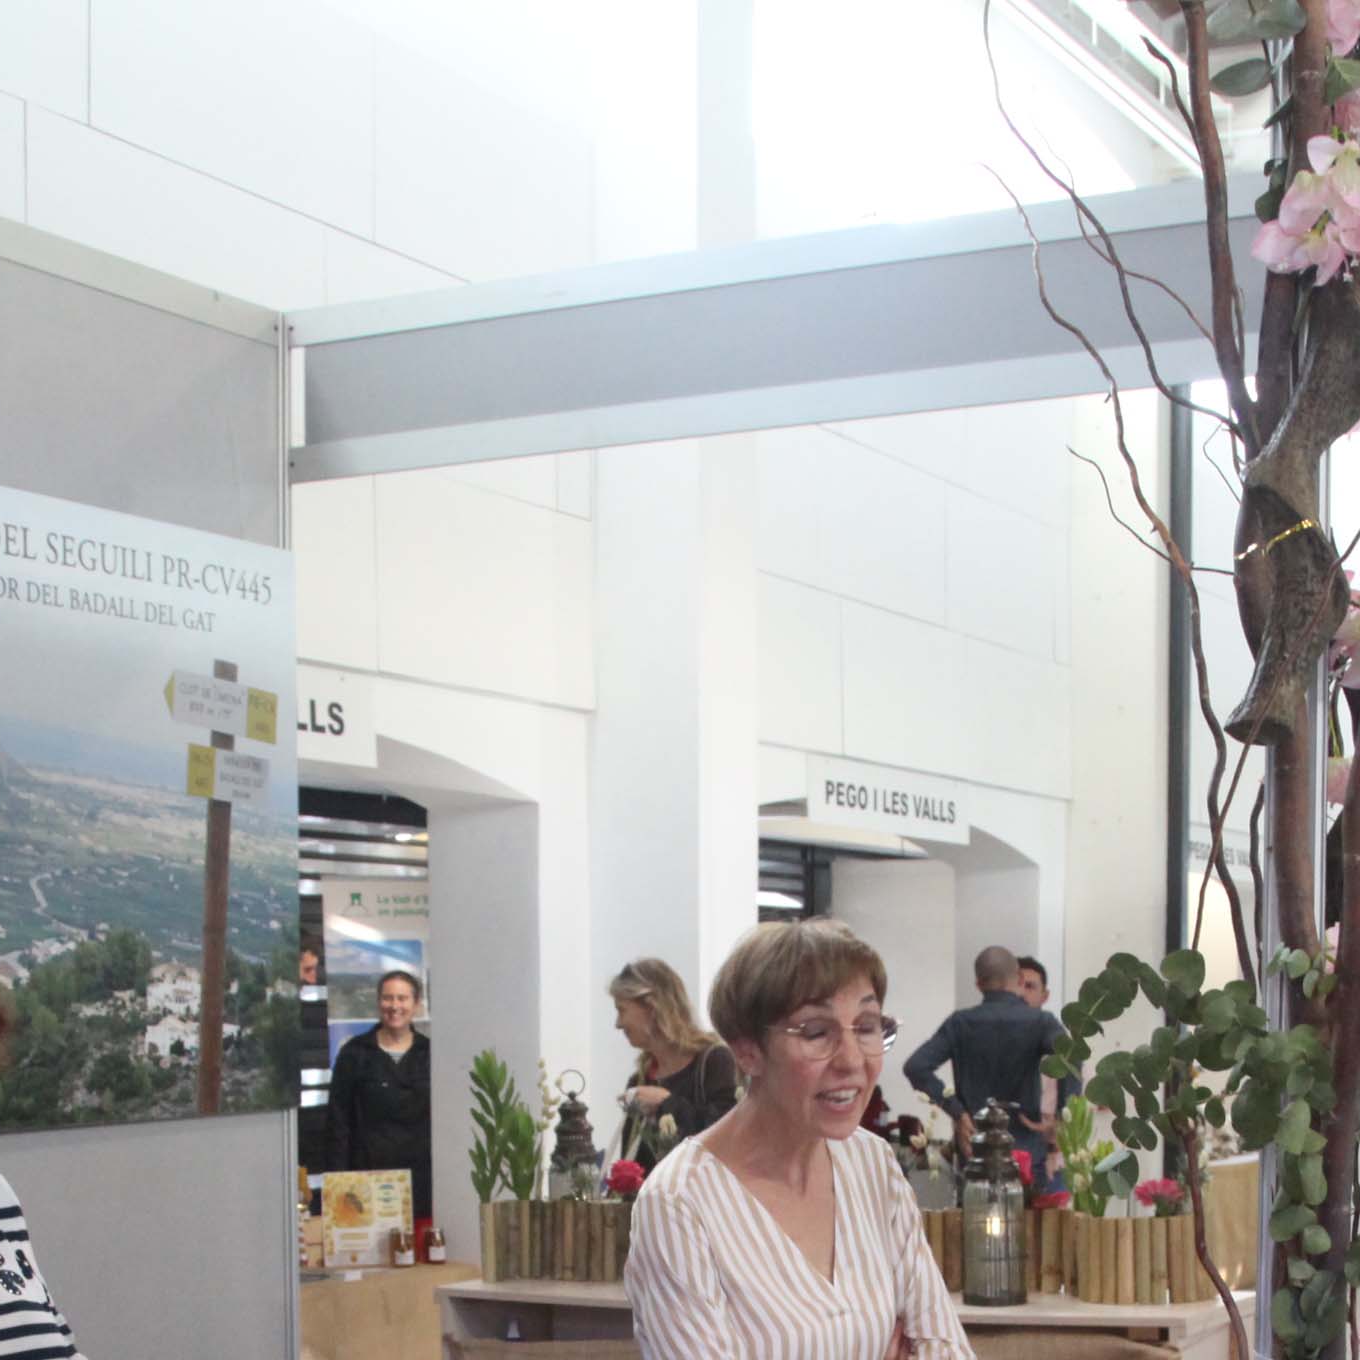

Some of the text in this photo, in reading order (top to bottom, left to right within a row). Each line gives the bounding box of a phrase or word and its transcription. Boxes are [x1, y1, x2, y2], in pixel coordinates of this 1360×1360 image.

[45, 532, 153, 582] SEGUILI
[162, 554, 272, 605] PR-CV445
[26, 581, 65, 608] DEL
[69, 588, 139, 620] BADALL
[144, 601, 178, 626] DEL
[182, 610, 217, 633] GAT
[825, 780, 956, 824] PEGO I LES VALLS
